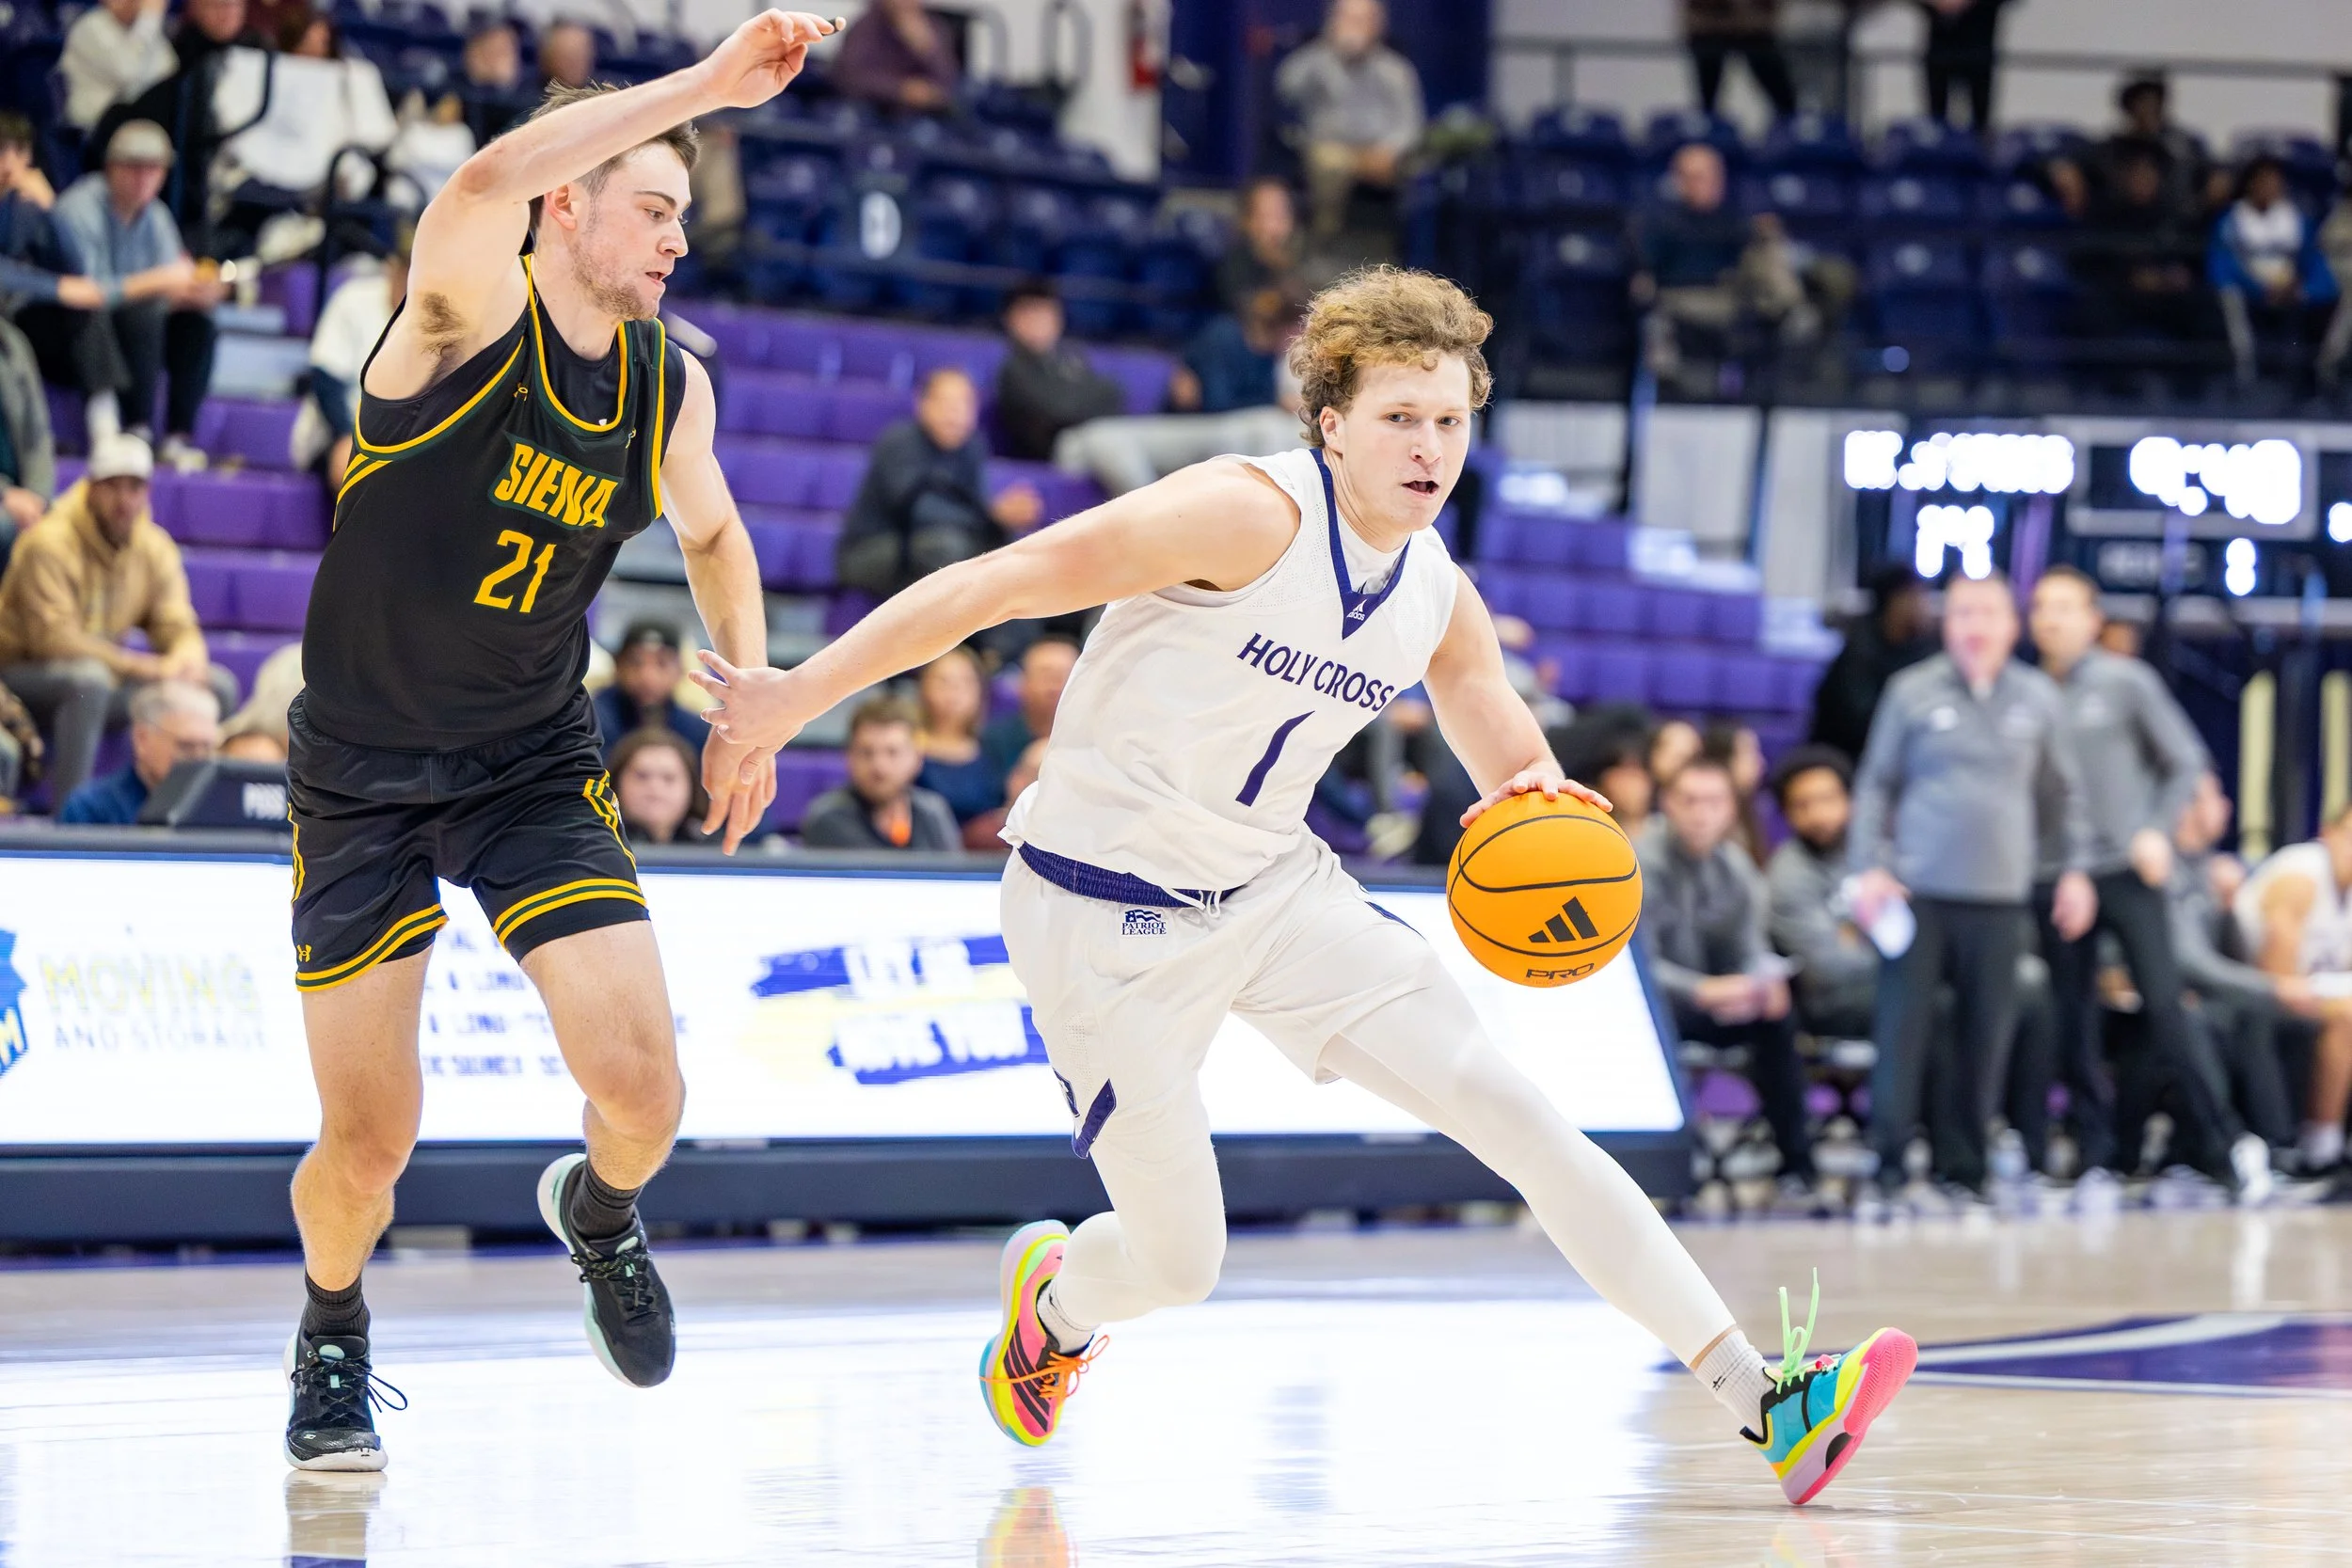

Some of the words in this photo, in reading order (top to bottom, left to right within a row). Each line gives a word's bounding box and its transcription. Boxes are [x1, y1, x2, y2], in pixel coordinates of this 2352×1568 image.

[494, 443, 618, 528] SIENA
[473, 530, 557, 612] 21
[1237, 633, 1318, 685] HOLY
[1314, 661, 1394, 712] CROSS
[1235, 710, 1315, 807] 1
[39, 953, 262, 1013] MOVING
[1526, 962, 1594, 979] PRO
